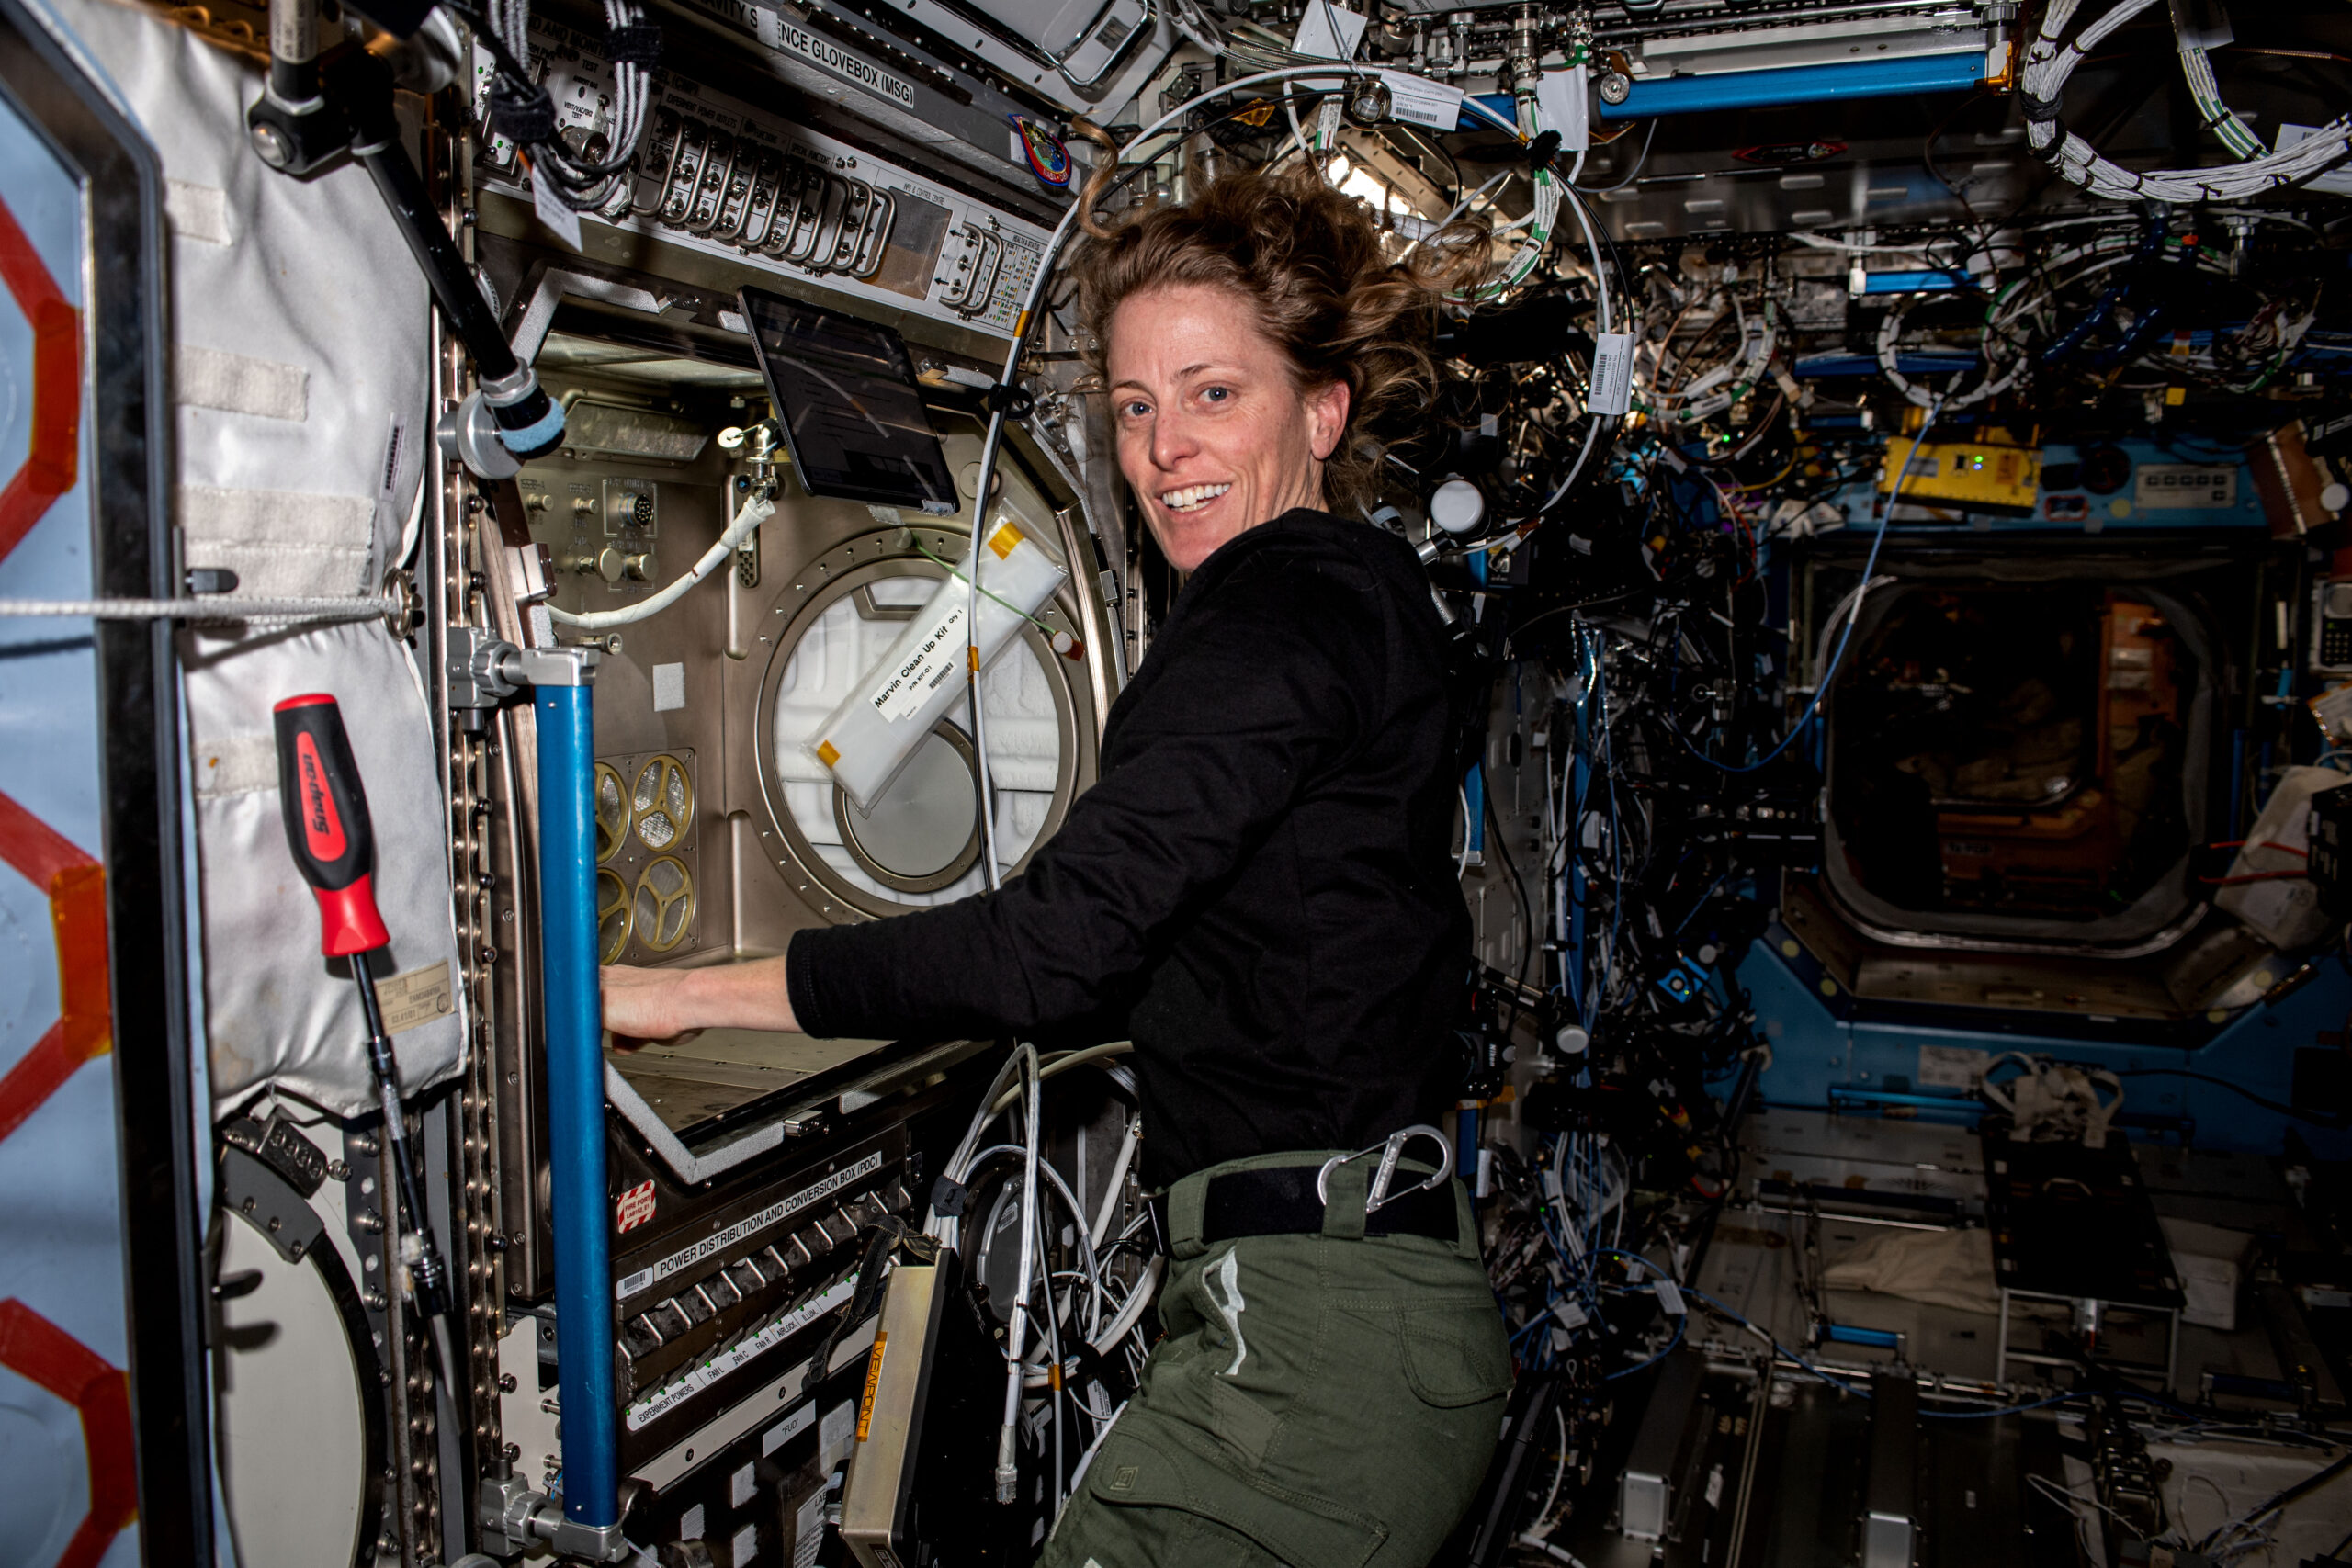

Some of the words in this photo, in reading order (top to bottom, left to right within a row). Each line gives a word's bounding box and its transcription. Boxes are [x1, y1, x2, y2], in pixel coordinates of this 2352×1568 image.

[582, 59, 599, 73] TEST
[812, 39, 878, 86] GLOVEBOX
[881, 75, 913, 106] (MSG)
[875, 679, 902, 708] Marvin
[901, 653, 924, 678] Clean
[922, 640, 936, 653] Up
[934, 626, 948, 640] Kit
[948, 614, 958, 624] Qty
[625, 1201, 636, 1213] FIRE
[637, 1194, 650, 1207] PORT
[660, 1247, 696, 1276] POWER
[699, 1214, 763, 1255] DISTRIBUTION
[765, 1204, 783, 1225] AND
[786, 1177, 838, 1213] CONVERSION
[840, 1167, 856, 1185] BOX
[857, 1156, 878, 1178] (PDC)
[802, 1308, 818, 1323] ILLUM.
[776, 1321, 797, 1337] AIRLOCK
[755, 1339, 765, 1351] FAN
[732, 1354, 743, 1366] FAN
[743, 1350, 750, 1359] C
[707, 1368, 718, 1380] FAN
[719, 1366, 725, 1375] L
[859, 1346, 884, 1434] VIEWPOINT
[638, 1396, 672, 1423] EXPERIMENT
[672, 1383, 695, 1406] POWERS
